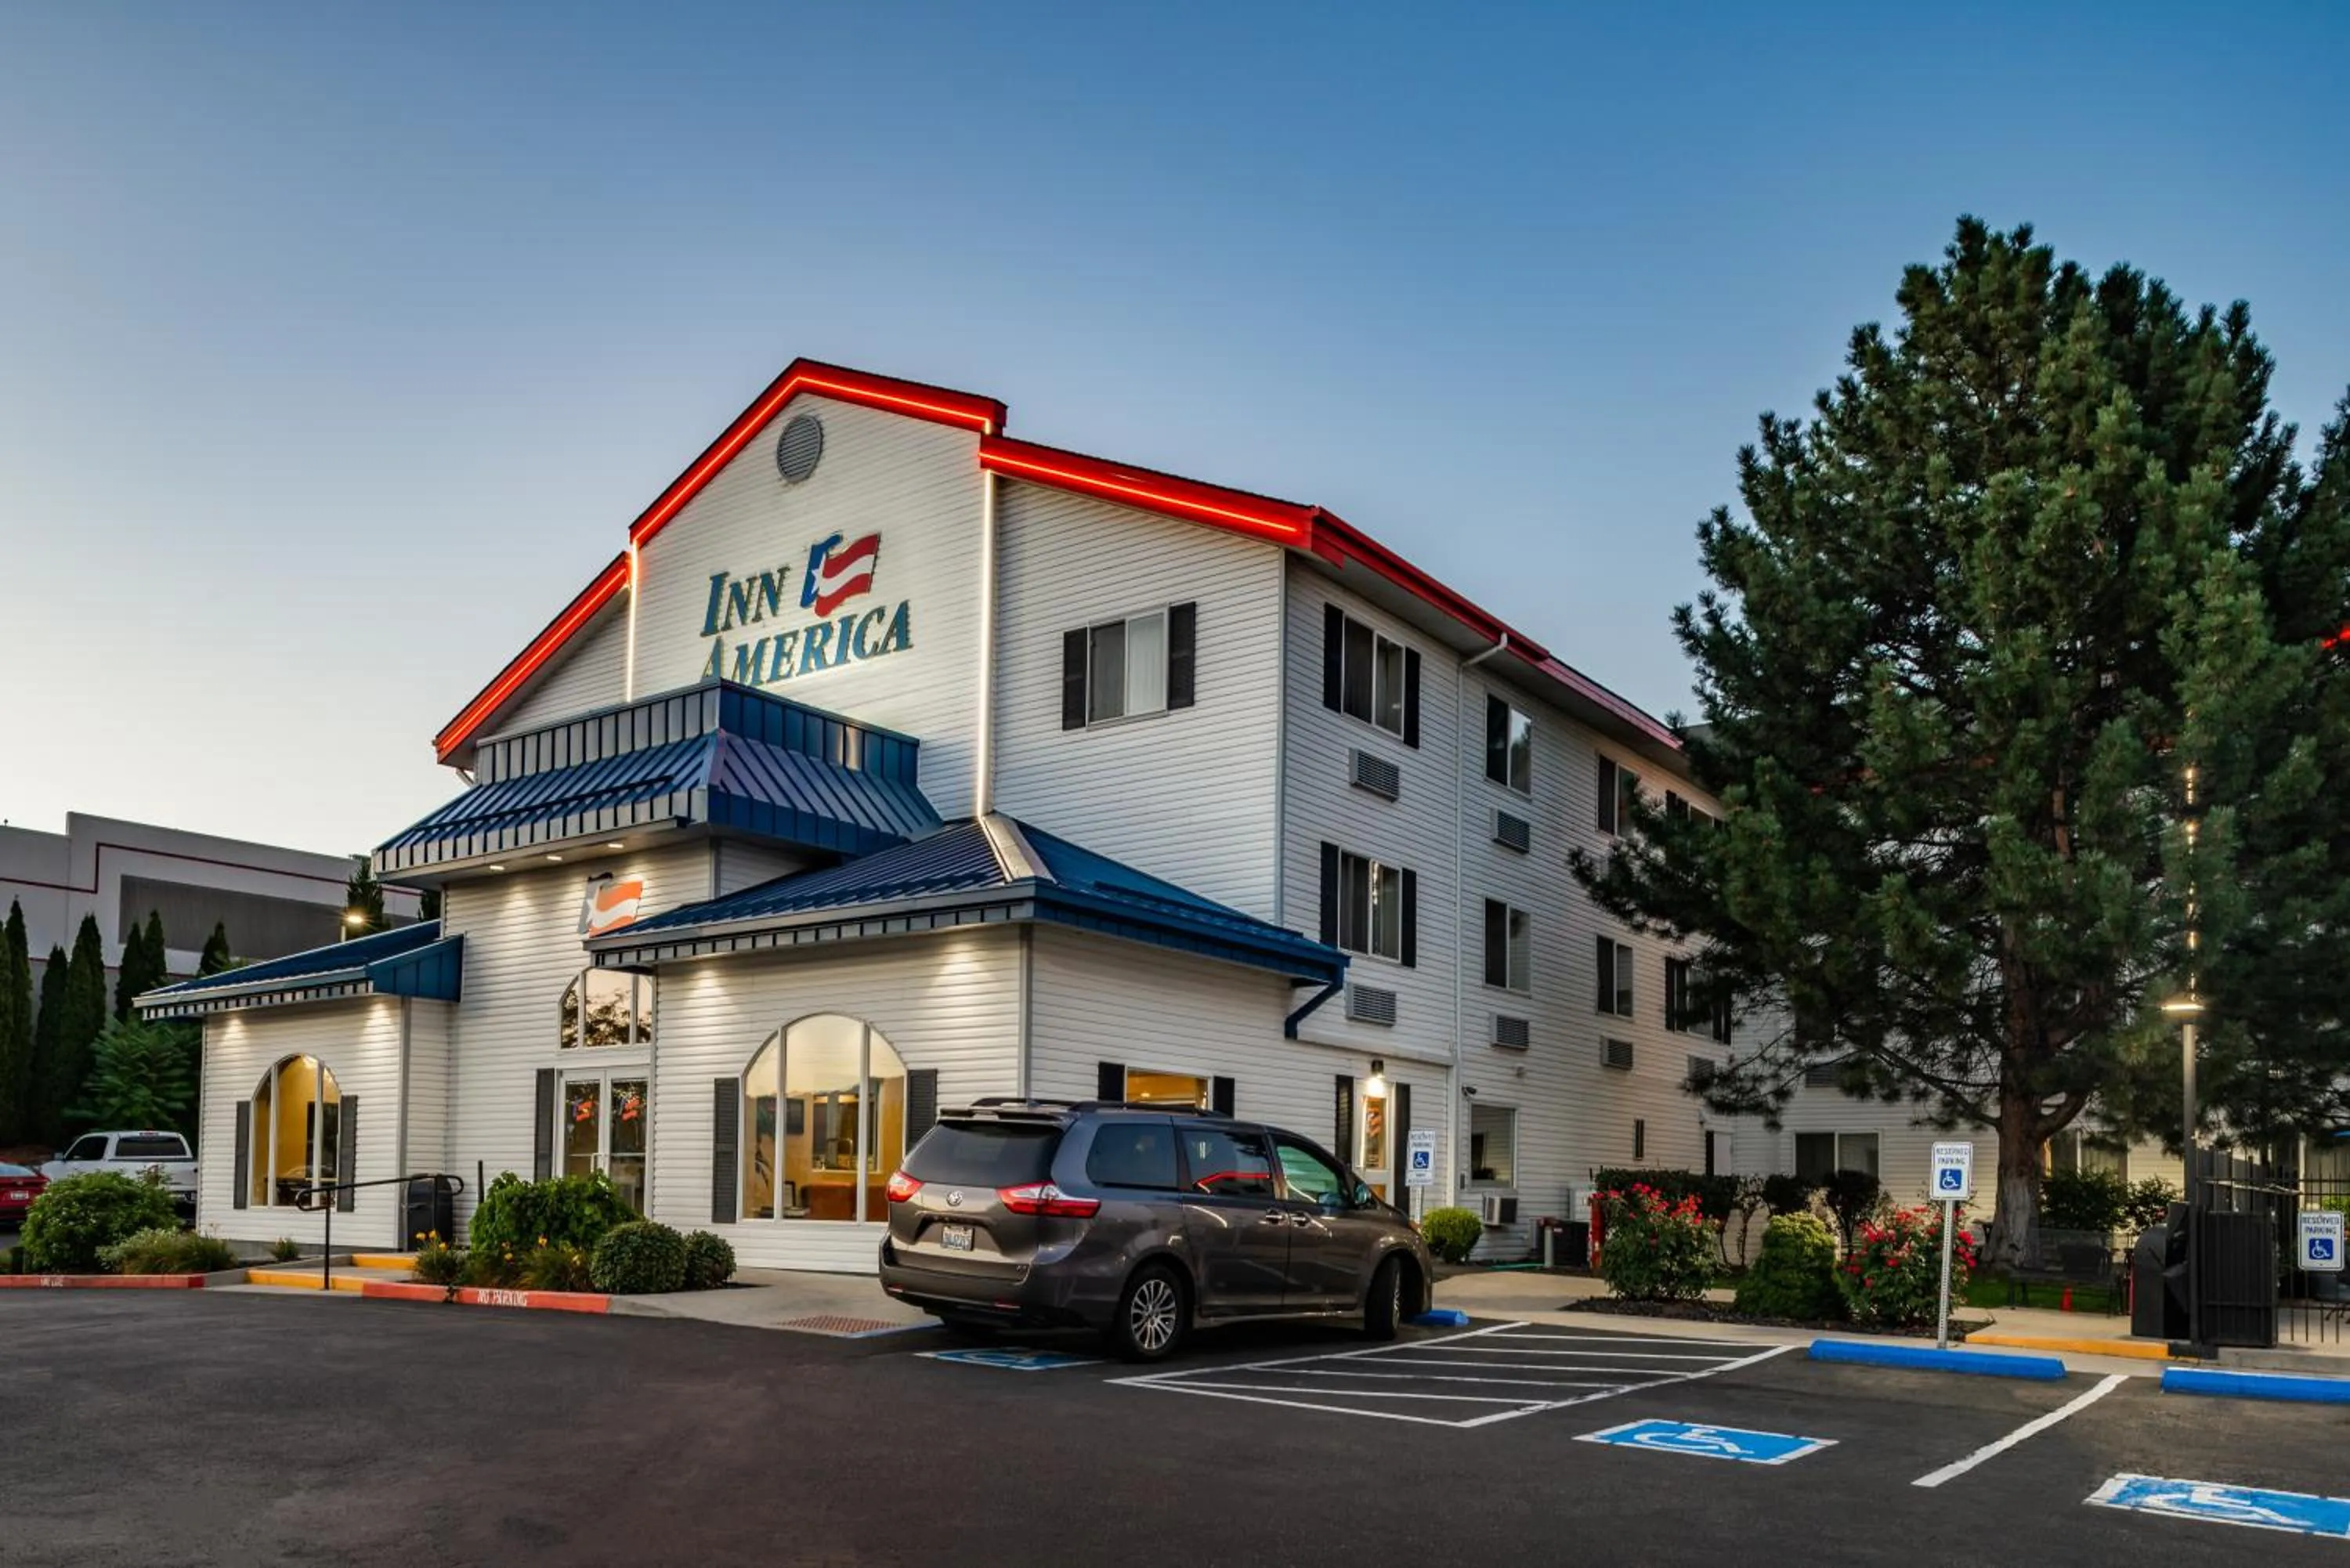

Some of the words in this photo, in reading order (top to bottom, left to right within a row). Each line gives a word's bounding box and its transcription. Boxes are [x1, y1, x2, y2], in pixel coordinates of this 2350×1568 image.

[700, 565, 791, 637] INN
[701, 599, 914, 687] AMERICA
[2301, 1216, 2340, 1225] RESERVED
[2305, 1226, 2337, 1234] PARKING
[477, 1290, 490, 1304] NO
